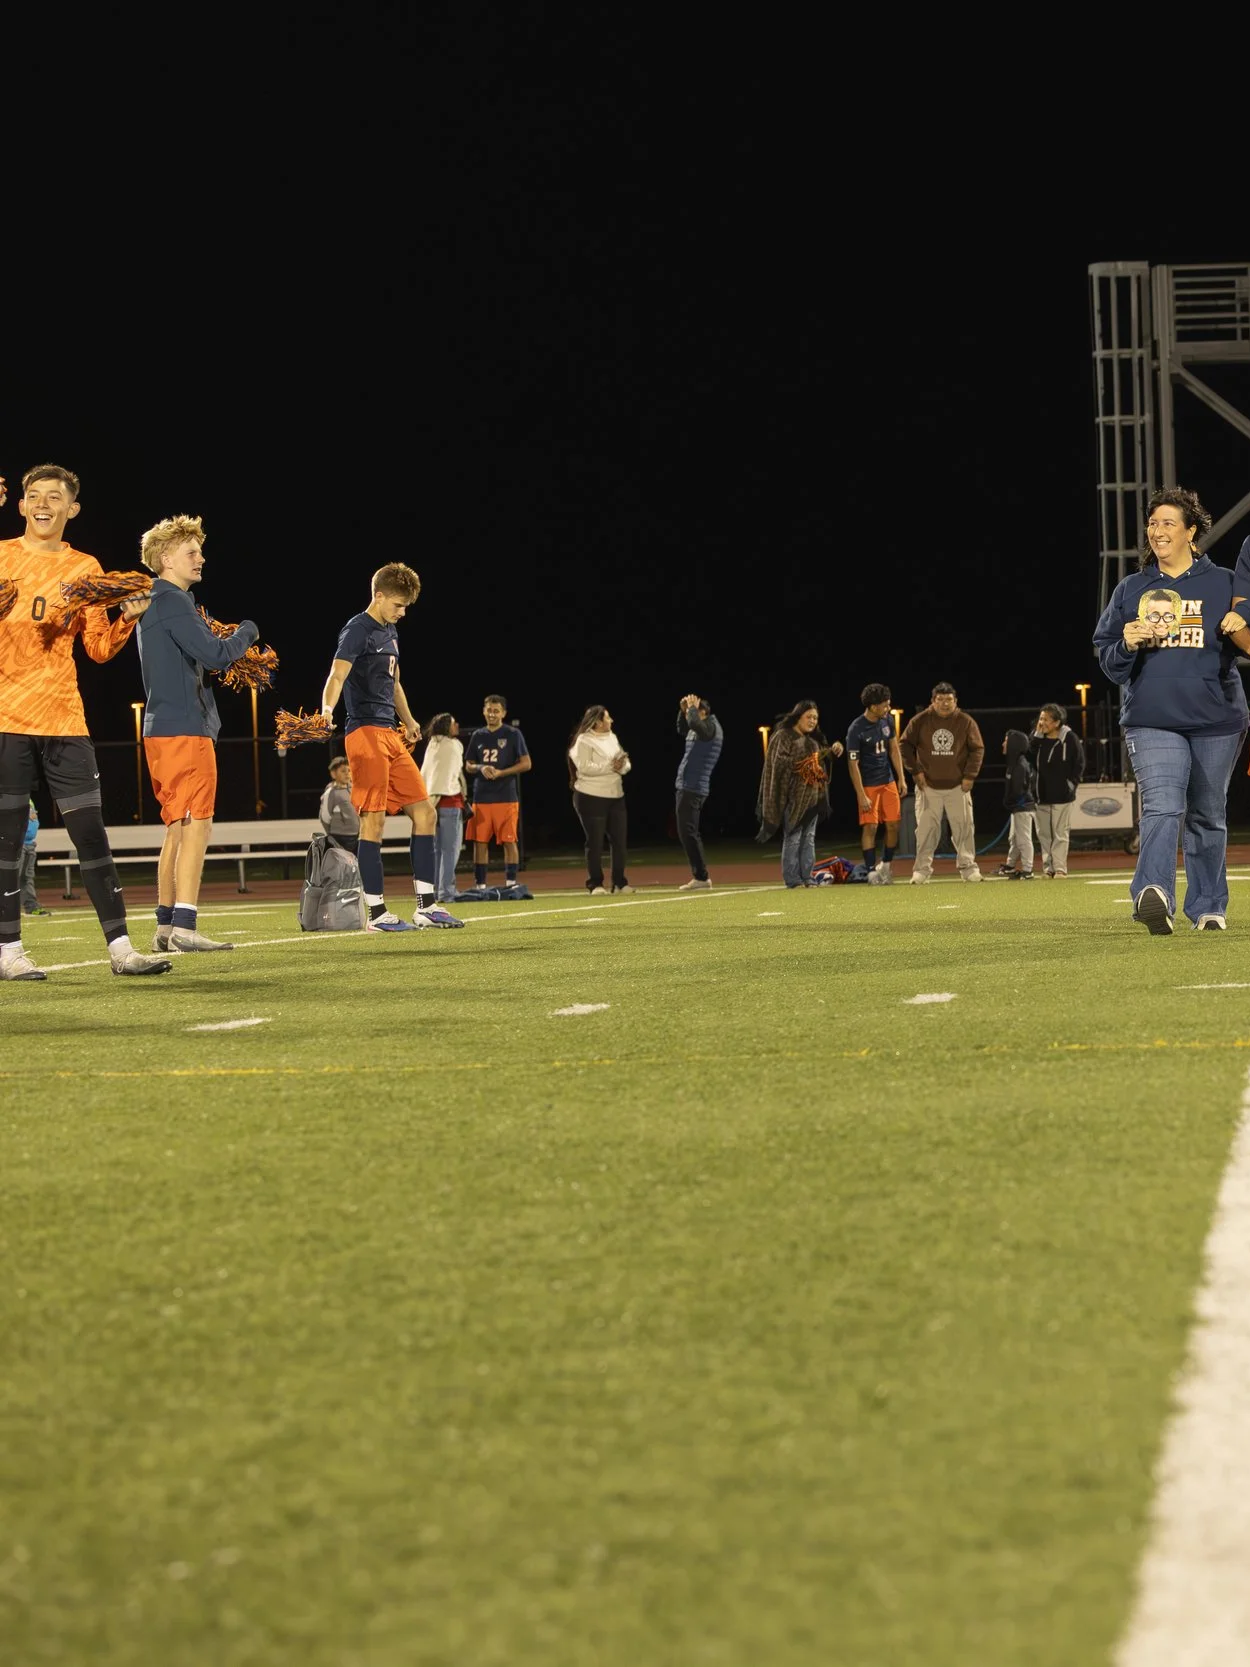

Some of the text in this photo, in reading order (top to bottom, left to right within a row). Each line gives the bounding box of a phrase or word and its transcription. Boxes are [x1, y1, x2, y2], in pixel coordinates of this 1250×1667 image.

[31, 595, 47, 622] 0
[875, 739, 886, 755] 11
[482, 748, 499, 763] 22
[850, 751, 858, 761] C
